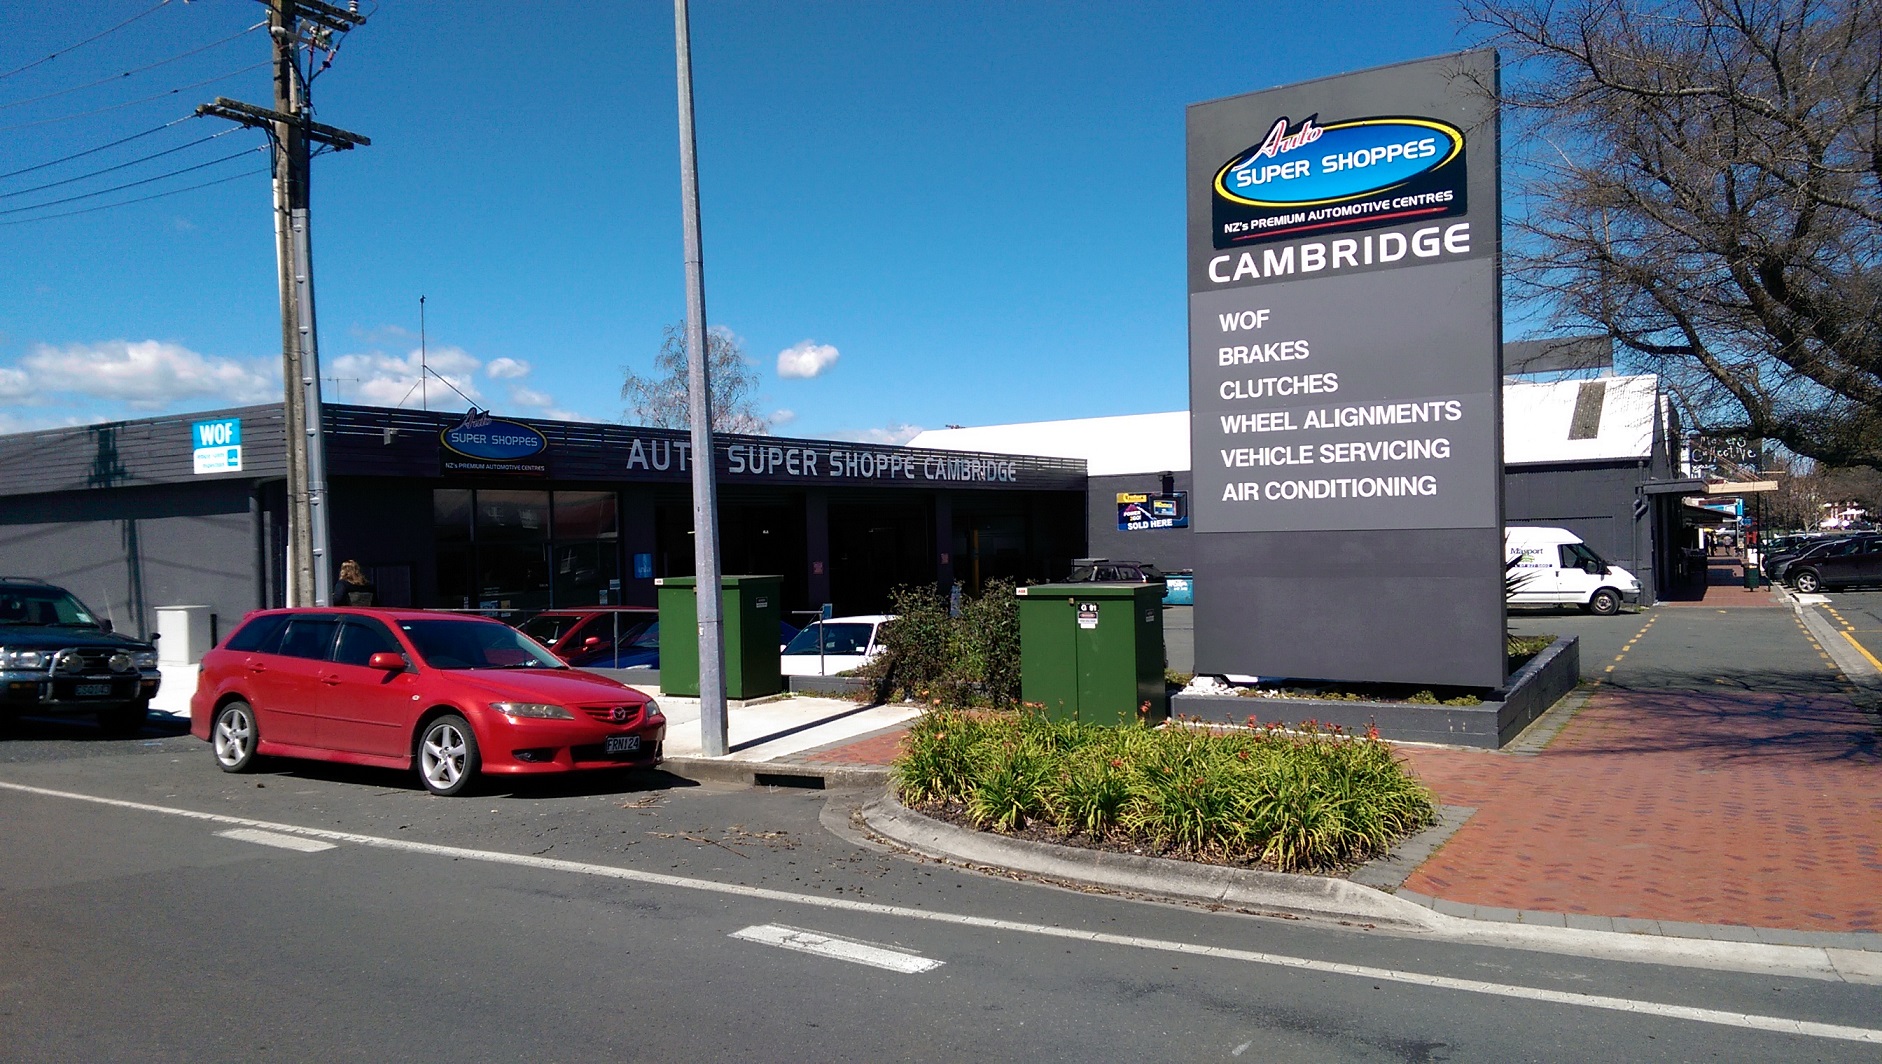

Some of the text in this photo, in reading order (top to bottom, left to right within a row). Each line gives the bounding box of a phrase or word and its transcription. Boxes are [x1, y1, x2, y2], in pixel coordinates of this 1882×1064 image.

[1231, 119, 1323, 170] Auto
[1236, 138, 1436, 187] SUPER SHOPPES
[1224, 190, 1453, 233] NZ's PREMIUM AUTOMOTIVE CENTRES
[1208, 222, 1470, 283] CAMBRIDGE
[1219, 309, 1270, 332] WOF
[1218, 340, 1310, 366] BRAKES
[1219, 373, 1339, 400] CLUTCHES
[1220, 400, 1462, 434] WHEEL ALIGNMENTS
[199, 422, 233, 446] WOF
[451, 432, 538, 447] SUPER SHOPPES
[626, 439, 1017, 482] AUT SUPER SHOPPE CAMBRIDGE
[1220, 438, 1451, 467] VEHICLE SERVICING
[458, 462, 485, 470] PREMIUM
[485, 463, 521, 471] AUTOMOTIVE
[521, 464, 545, 472] CENTRES
[1221, 475, 1437, 502] AIR CONDITIONING
[1127, 518, 1173, 531] SOLD HERE
[607, 737, 639, 750] FRN124
